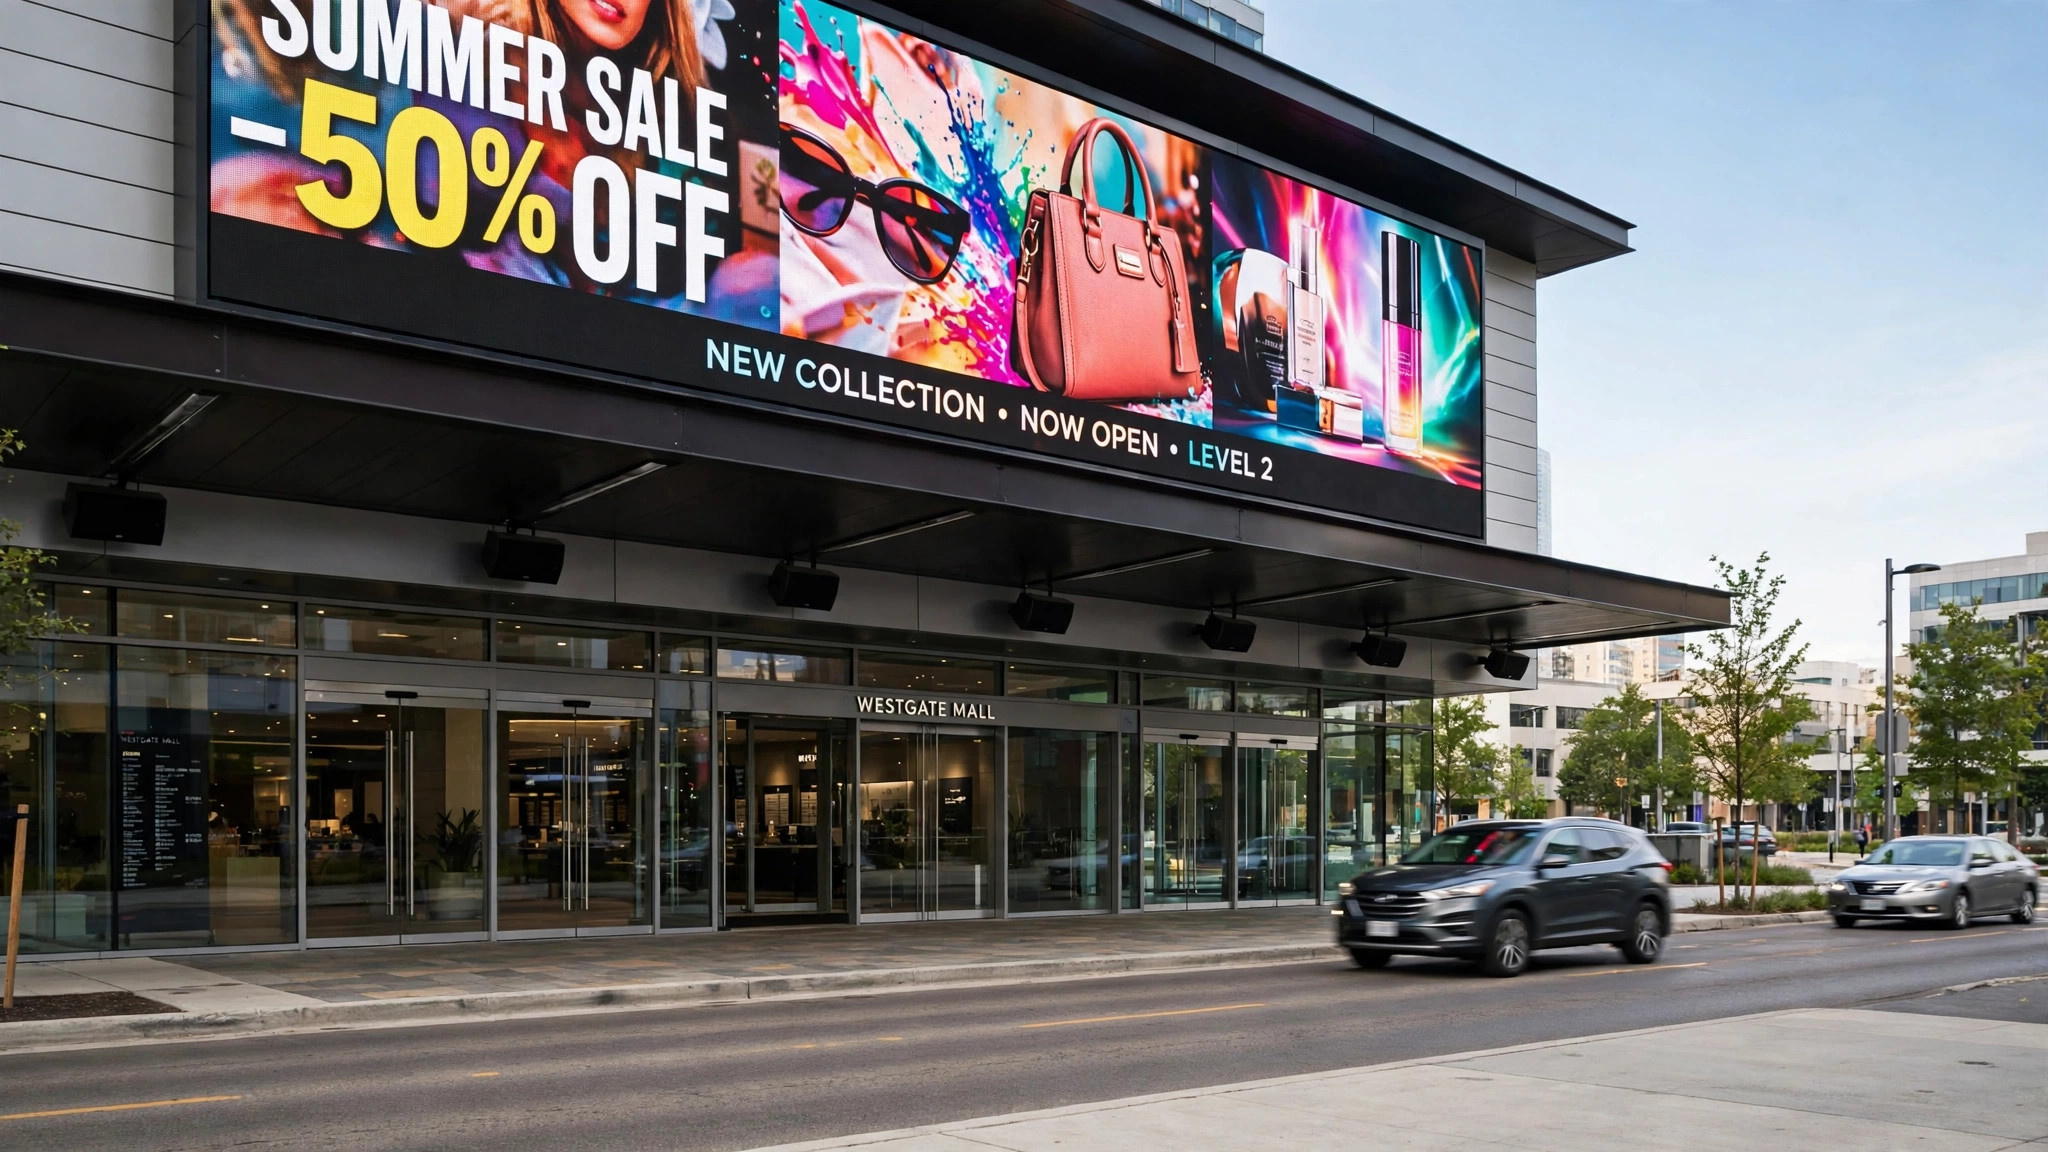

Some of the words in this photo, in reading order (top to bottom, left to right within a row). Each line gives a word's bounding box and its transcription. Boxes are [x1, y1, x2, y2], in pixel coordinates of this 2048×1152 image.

[261, 0, 568, 132] SUMMER
[585, 56, 728, 177] SALE
[572, 155, 730, 303] OFF
[706, 338, 786, 383] NEW
[795, 357, 985, 423] COLLECTION
[1020, 404, 1085, 443] NOW
[1091, 420, 1159, 458] OPEN
[1188, 439, 1256, 478] LEVEL
[1260, 456, 1274, 482] 2
[857, 695, 947, 717] WESTGATE
[953, 702, 996, 720] MALL
